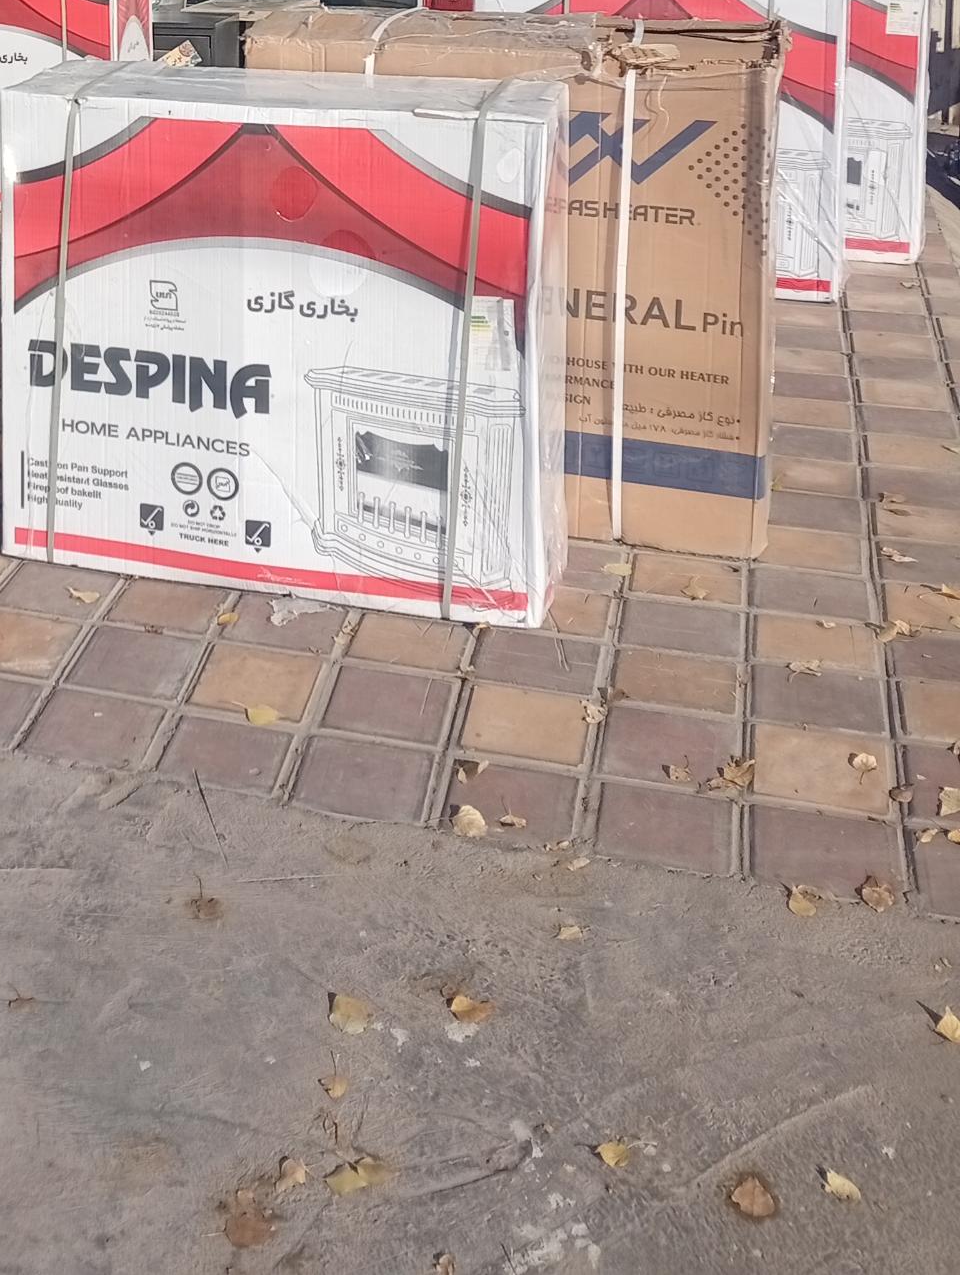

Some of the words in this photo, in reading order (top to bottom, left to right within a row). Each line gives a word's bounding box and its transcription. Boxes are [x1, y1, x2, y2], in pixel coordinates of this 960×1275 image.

[0, 52, 28, 65] بخاری
[603, 201, 695, 226] HATER
[246, 290, 295, 313] گازی
[299, 298, 359, 323] بخاری
[702, 311, 745, 338] Pin
[27, 338, 272, 420] DESPINA
[566, 356, 608, 371] HOUSE
[617, 362, 644, 375] ITH
[648, 366, 676, 379] OUR
[680, 369, 730, 385] HEATER
[61, 418, 119, 438] HOME
[125, 426, 251, 457] APPLIANCES
[71, 462, 88, 473] Pan
[91, 465, 128, 478] Support
[92, 478, 129, 491] Glasses
[54, 499, 83, 511] uality
[179, 532, 206, 544] TRUCK
[207, 536, 230, 547] HERE
